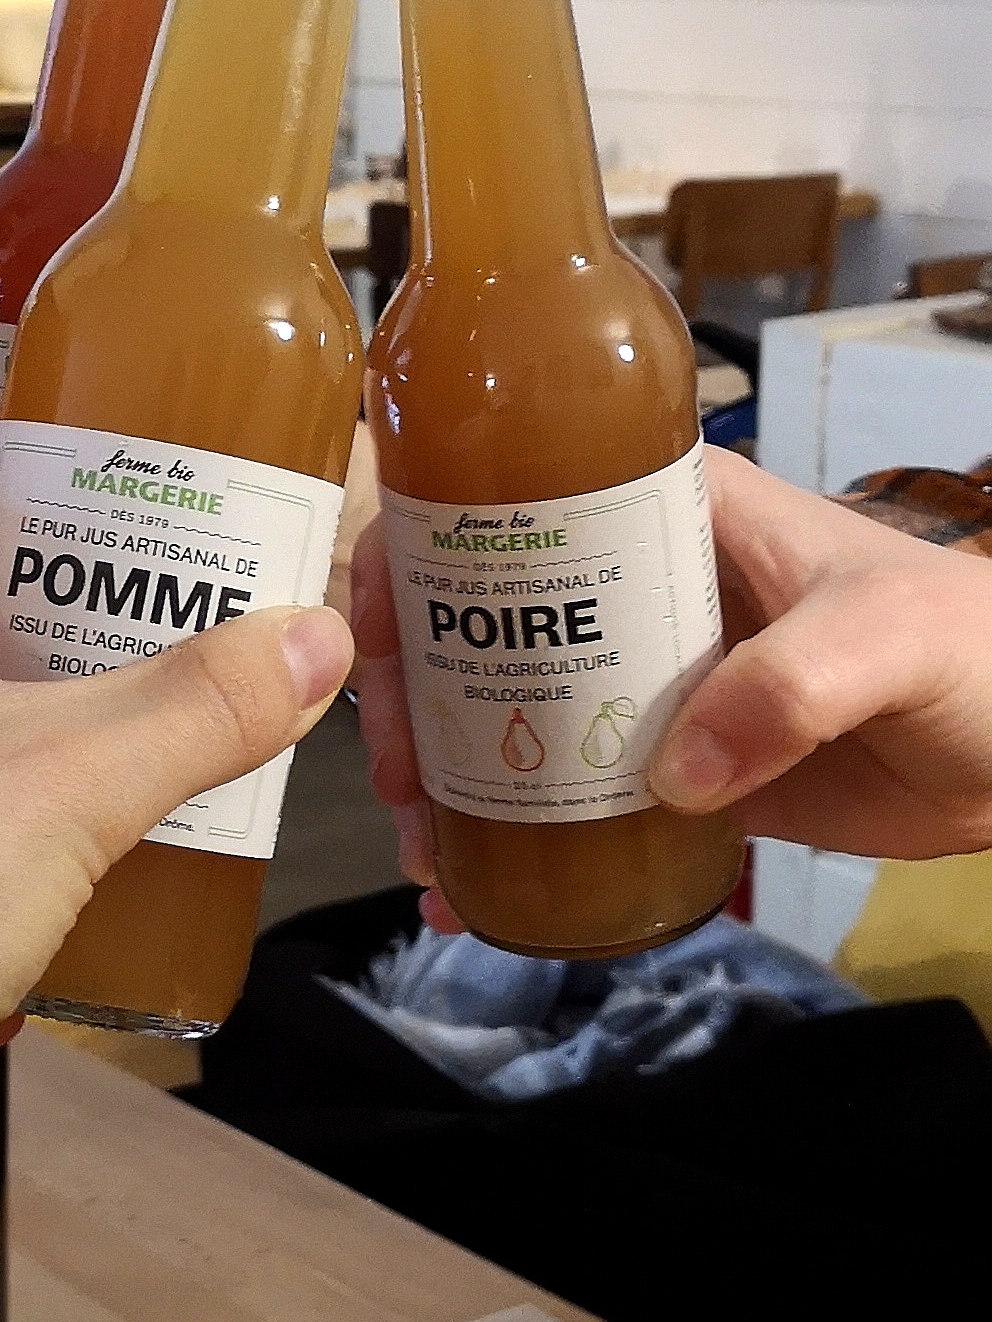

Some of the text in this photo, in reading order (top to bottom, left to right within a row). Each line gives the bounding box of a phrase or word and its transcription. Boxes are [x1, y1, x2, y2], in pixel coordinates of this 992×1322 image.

[101, 449, 196, 482] ferme bio
[70, 467, 224, 516] MARGERIE
[138, 514, 169, 529] 1979
[20, 516, 259, 578] LE PUR JUS ARTISANAL DE
[431, 529, 567, 552] MARGERIE
[456, 579, 487, 595] JUS
[491, 573, 595, 596] ARTISANAL
[598, 565, 623, 584] DE
[9, 614, 48, 636] ISSU
[51, 622, 77, 643] DE
[427, 598, 603, 649] POIRE
[459, 659, 479, 675] DE
[464, 684, 573, 702] BIOLOGIQUE
